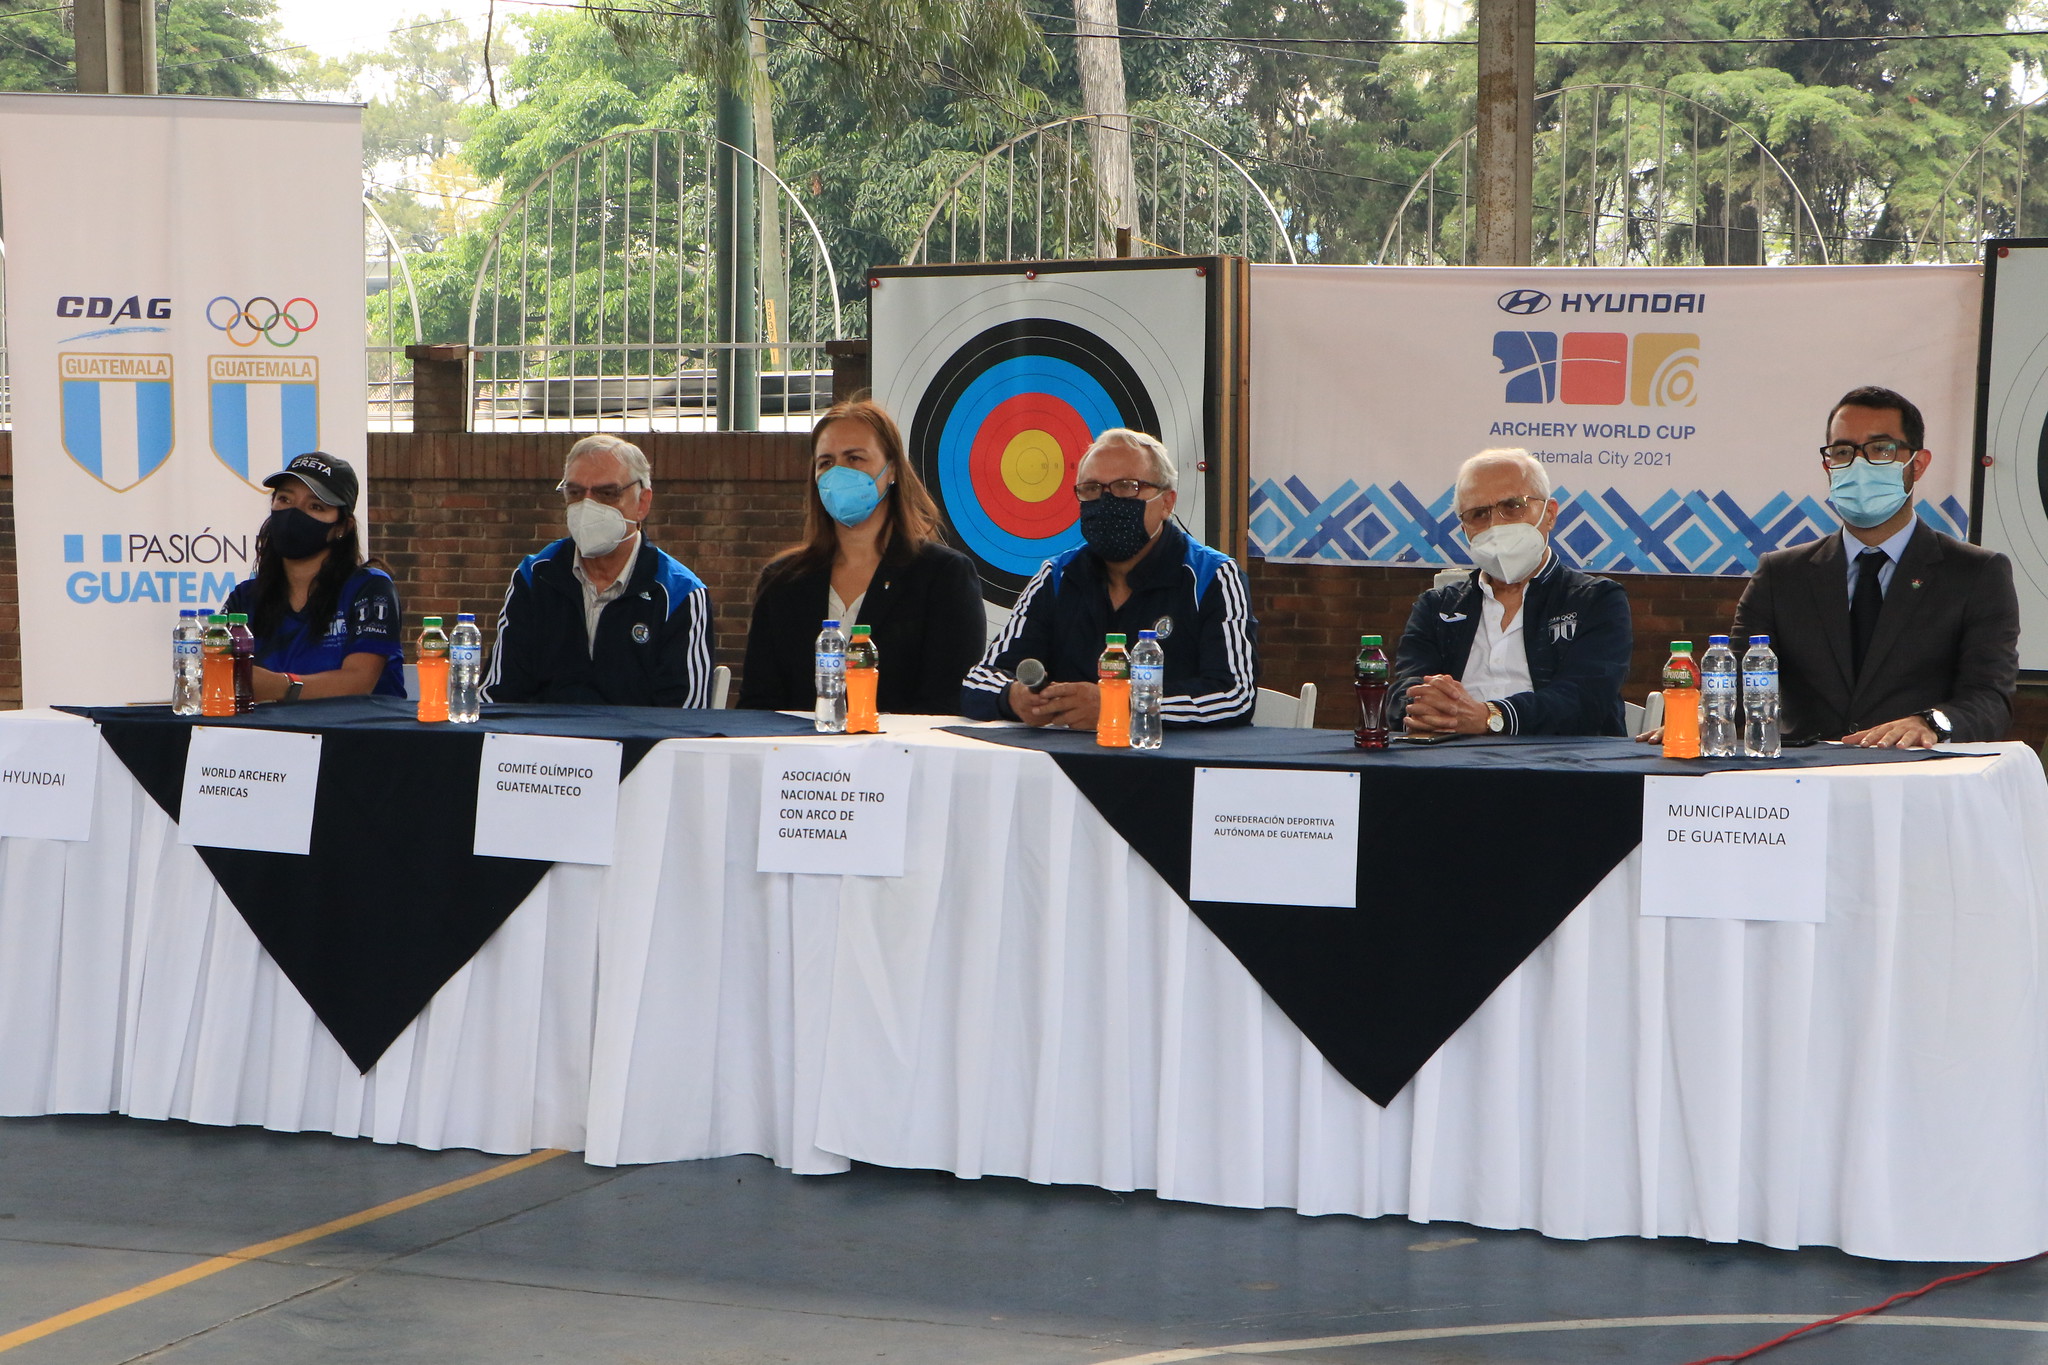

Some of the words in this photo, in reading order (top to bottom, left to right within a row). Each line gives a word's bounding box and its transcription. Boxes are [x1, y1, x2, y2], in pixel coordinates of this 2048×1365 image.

[56, 295, 171, 325] CDAG
[1561, 293, 1705, 313] HYUNDAI
[766, 301, 777, 361] 39371
[65, 358, 167, 376] GUATEMALA
[214, 360, 312, 378] GUATEMALA
[1489, 421, 1578, 437] ARCHERY
[1582, 423, 1651, 439] WORLD
[1656, 425, 1696, 440] CUP
[1070, 462, 1075, 470] 8
[1528, 450, 1593, 464] atemala
[1598, 450, 1629, 468] City
[1634, 452, 1671, 466] 2021
[291, 459, 332, 477] CRETA
[128, 527, 247, 564] PASIÓN
[66, 570, 256, 604] GUATEM
[452, 651, 473, 661] ELO
[1131, 670, 1152, 680] ELO
[1745, 676, 1770, 687] ELO
[2, 769, 65, 787] HYUNDAI
[201, 766, 237, 779] WORLD
[238, 769, 287, 783] ARCHERY
[498, 762, 537, 775] COMITÉ
[540, 764, 593, 779] OLÍMPICO
[782, 769, 851, 782] ASOCIACIÓN
[198, 784, 249, 798] AMERICAS
[496, 780, 581, 797] GUATEMALTECO
[781, 789, 838, 801] NACIONAL
[841, 791, 855, 802] DE
[858, 791, 885, 803] TIRO
[779, 808, 803, 819] CON
[806, 809, 837, 820] ARCO
[840, 810, 855, 821] DE
[1214, 814, 1284, 825] CONFEDERACIÓN
[1286, 817, 1335, 827] DEPORTIVA
[1668, 804, 1790, 820] MUNICIPALIDAD
[778, 827, 847, 840] GUATEMALA
[1214, 827, 1265, 838] AUTÓNOMA
[1267, 829, 1278, 838] DE
[1280, 830, 1334, 840] GUATEMALA
[1667, 829, 1686, 842] DE
[1691, 830, 1787, 845] GUATEMALA
